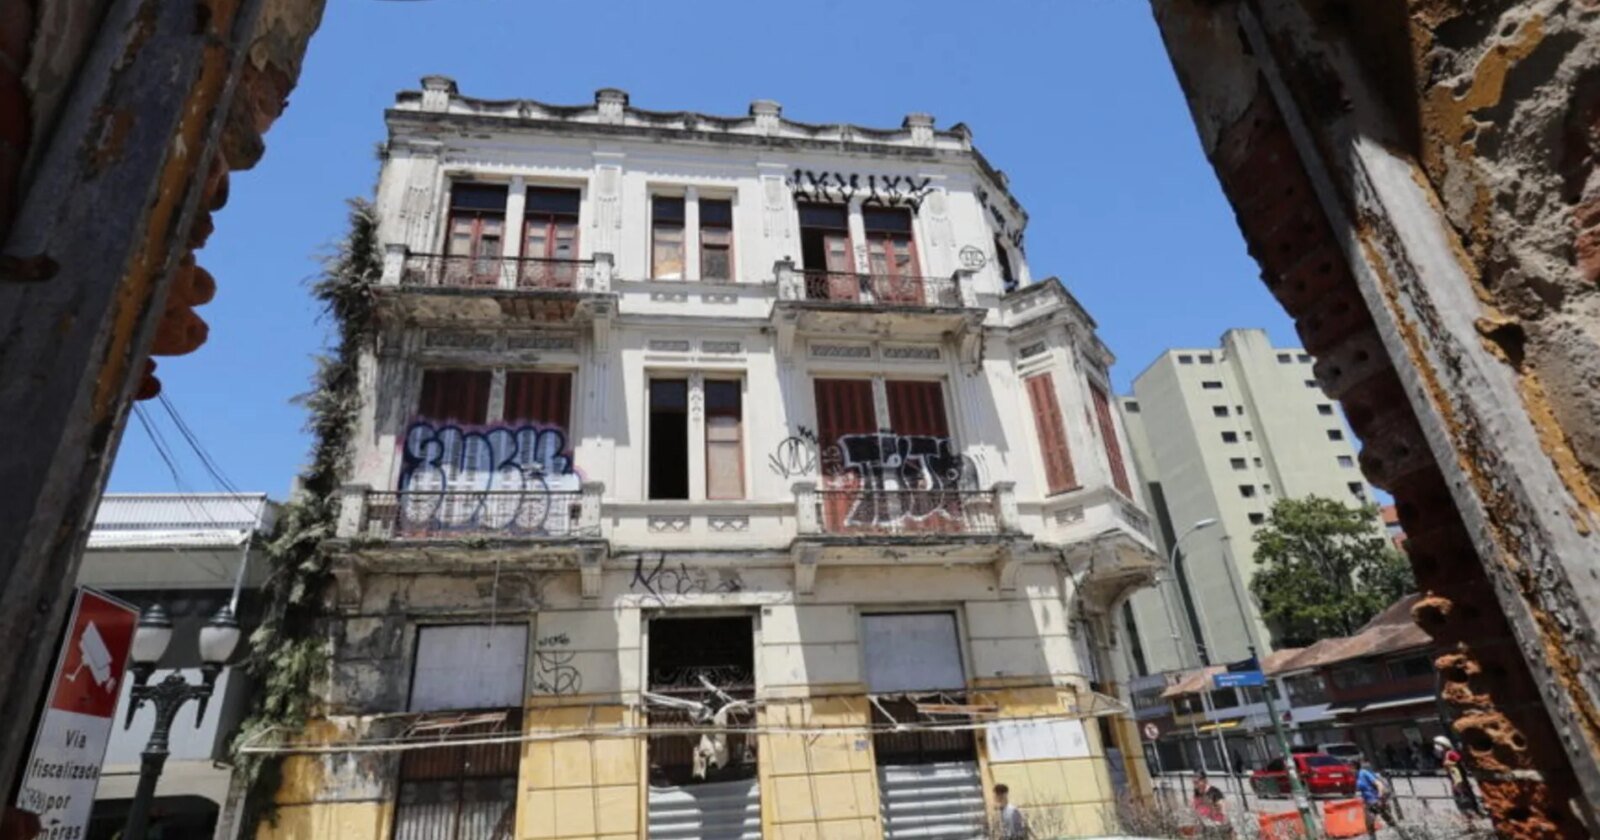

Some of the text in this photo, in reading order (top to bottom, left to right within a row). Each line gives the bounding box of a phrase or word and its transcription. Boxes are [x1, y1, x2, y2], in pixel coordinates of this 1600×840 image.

[65, 730, 87, 748] Via
[32, 759, 99, 779] fiscalizada
[44, 795, 71, 814] por
